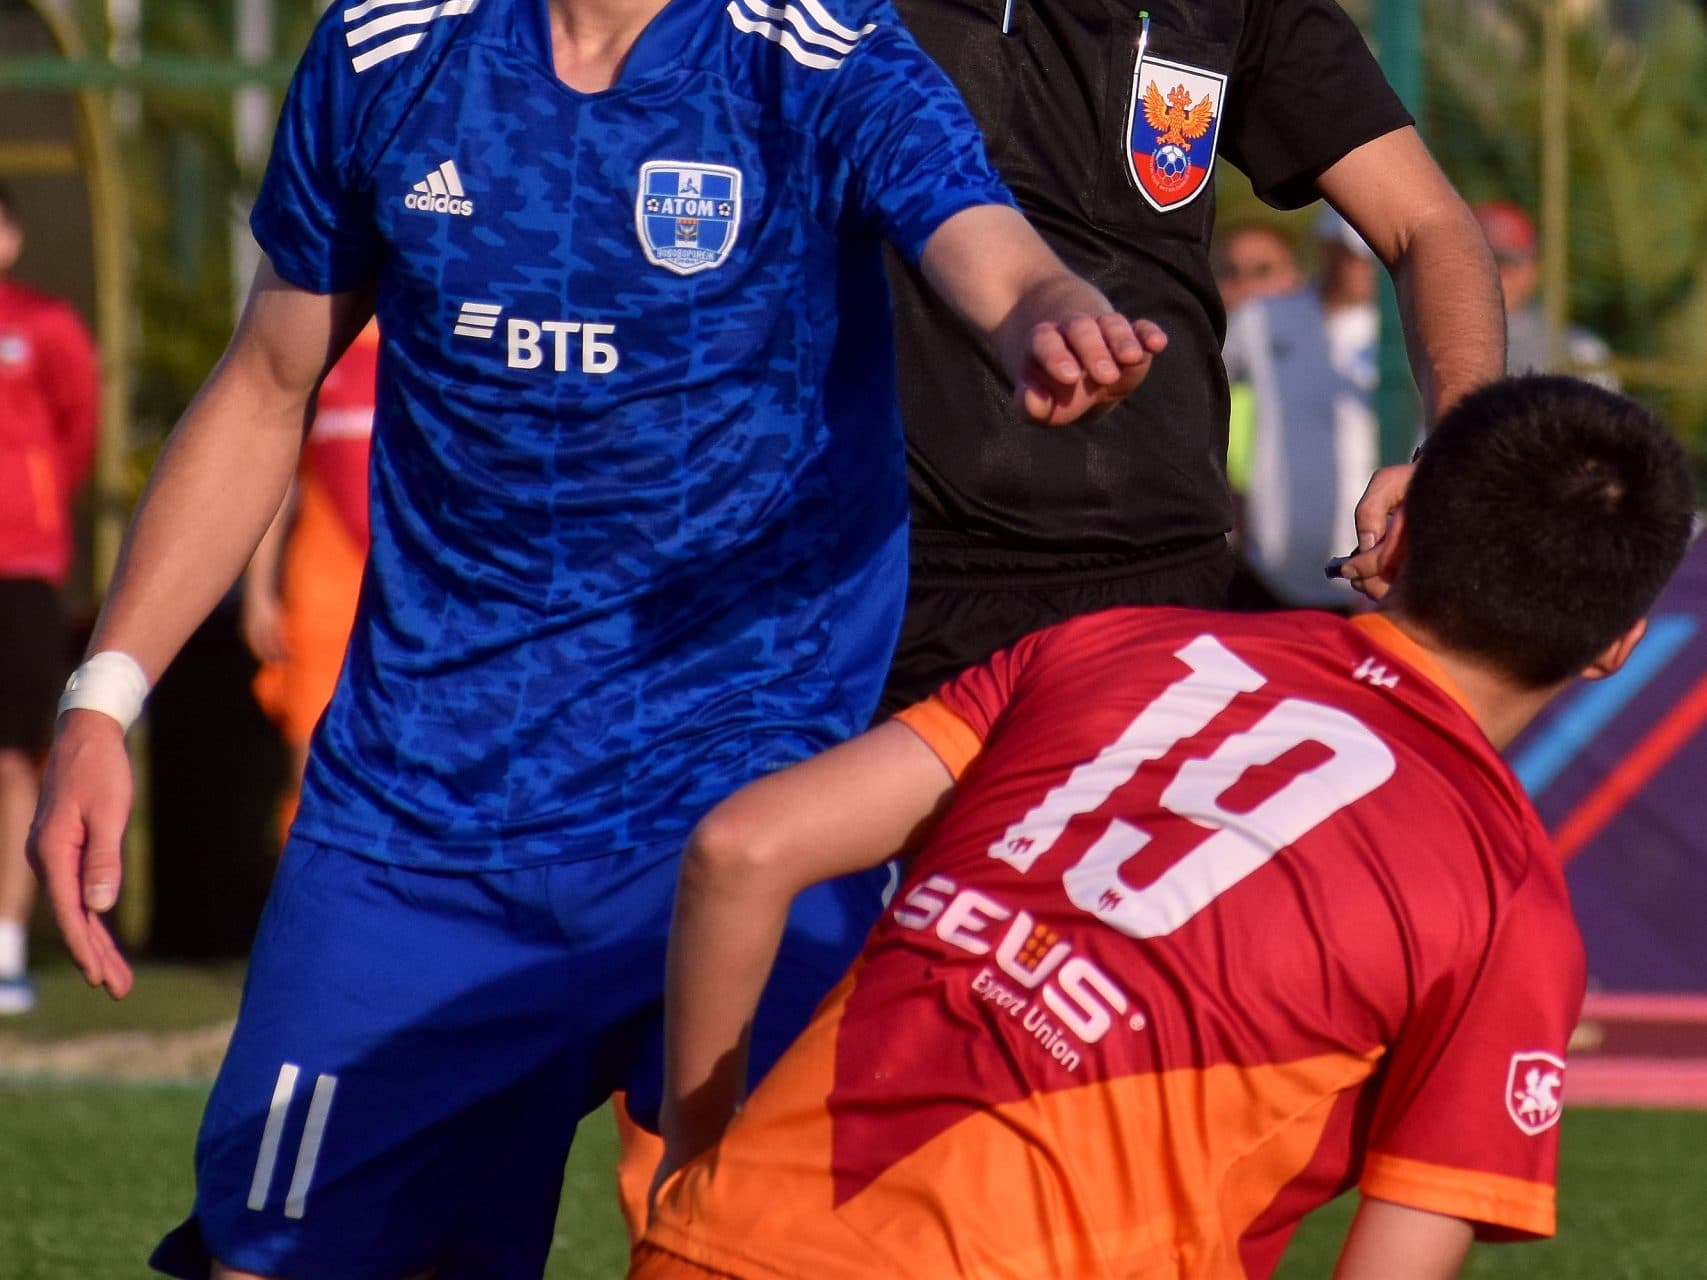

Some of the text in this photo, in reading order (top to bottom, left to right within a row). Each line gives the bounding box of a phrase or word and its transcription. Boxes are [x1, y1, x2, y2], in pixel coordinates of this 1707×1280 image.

[404, 192, 473, 216] adidas
[661, 197, 715, 217] АТОМ
[507, 318, 619, 375] ВТБ
[987, 633, 1397, 940] 19
[893, 873, 1129, 1044] SEUS
[1023, 1005, 1081, 1073] Union
